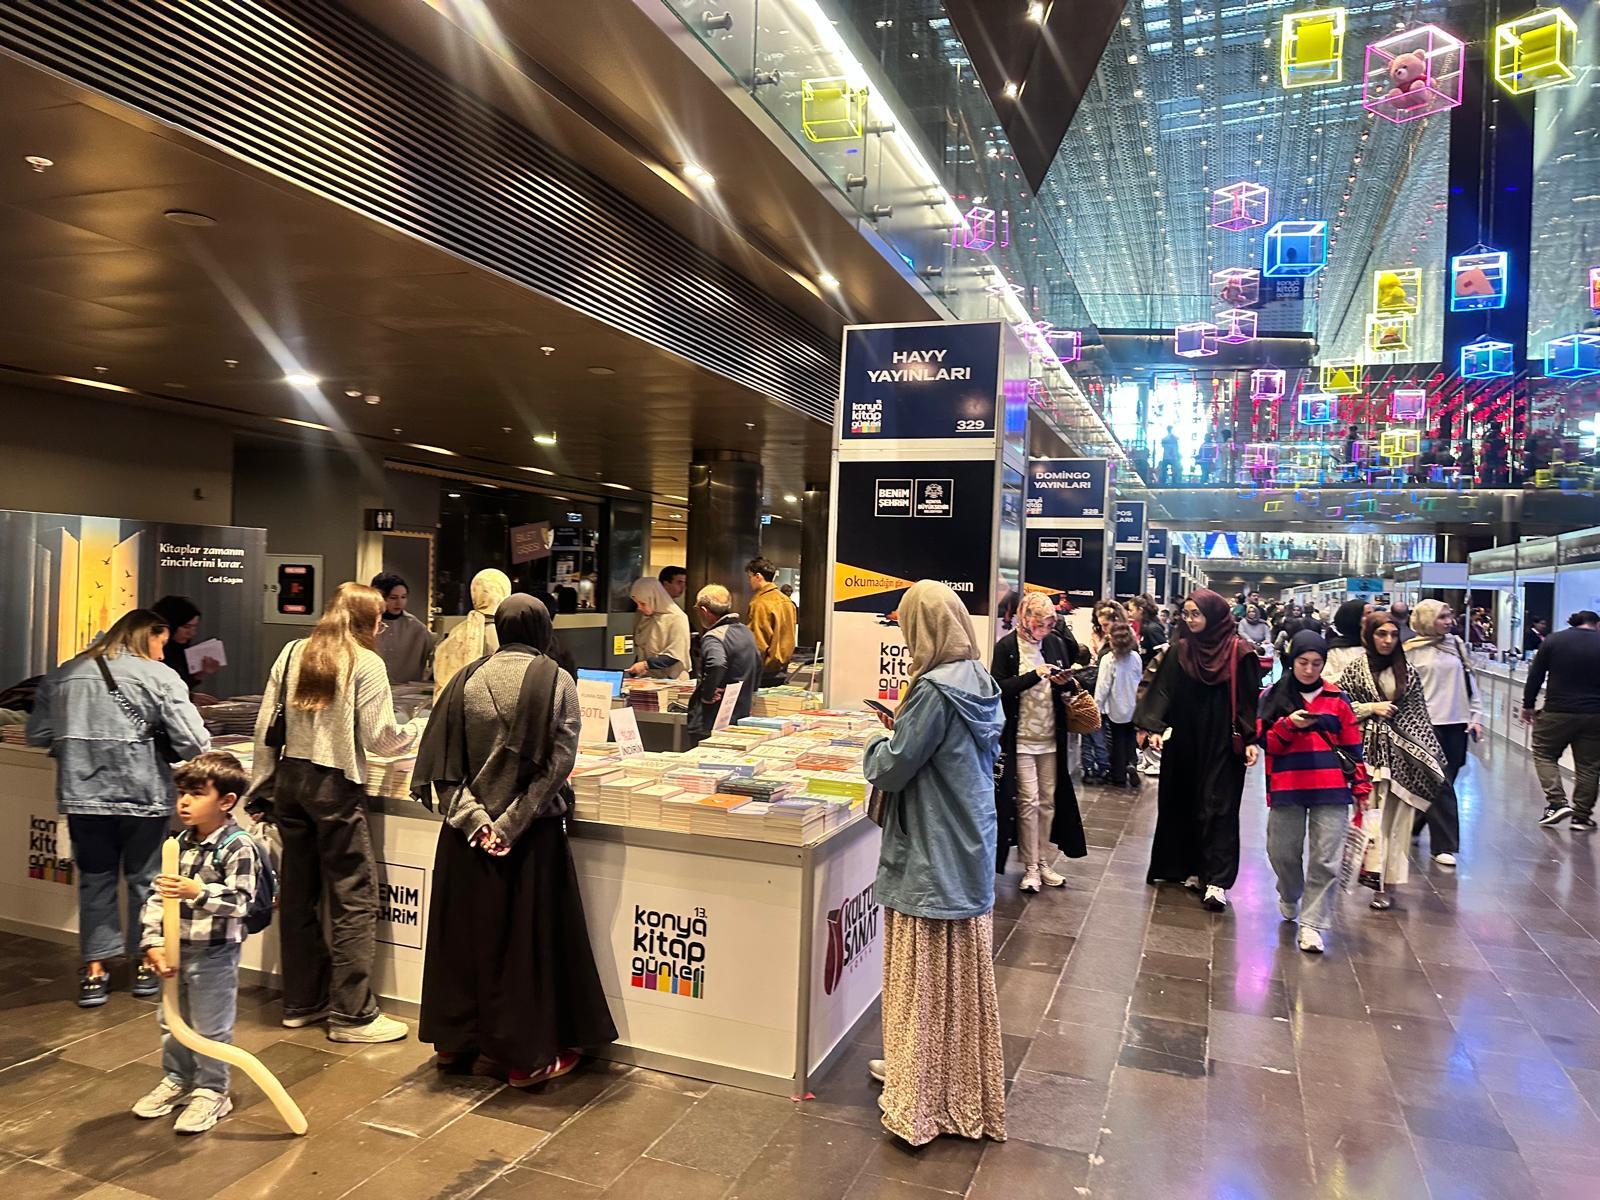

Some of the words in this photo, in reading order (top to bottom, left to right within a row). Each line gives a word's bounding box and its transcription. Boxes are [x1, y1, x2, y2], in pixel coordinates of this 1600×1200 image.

[892, 350, 947, 363] HAYY
[867, 367, 971, 382] YAYINLARI
[852, 411, 882, 420] kitap
[957, 420, 985, 429] 329
[1035, 466, 1091, 479] DOMİNGO
[1034, 481, 1092, 489] YAYINLARI
[159, 543, 201, 555] Kitaplar
[203, 547, 245, 556] zamanın
[160, 557, 215, 568] zincirlerini
[222, 576, 244, 584] Sagan
[880, 642, 909, 657] kon
[880, 657, 914, 676] kit
[378, 883, 418, 906] ENİM
[694, 907, 707, 919] 13.
[635, 905, 707, 938] konya
[843, 905, 879, 967] SANAT
[634, 927, 706, 965] kitap
[632, 956, 705, 983] günleri
